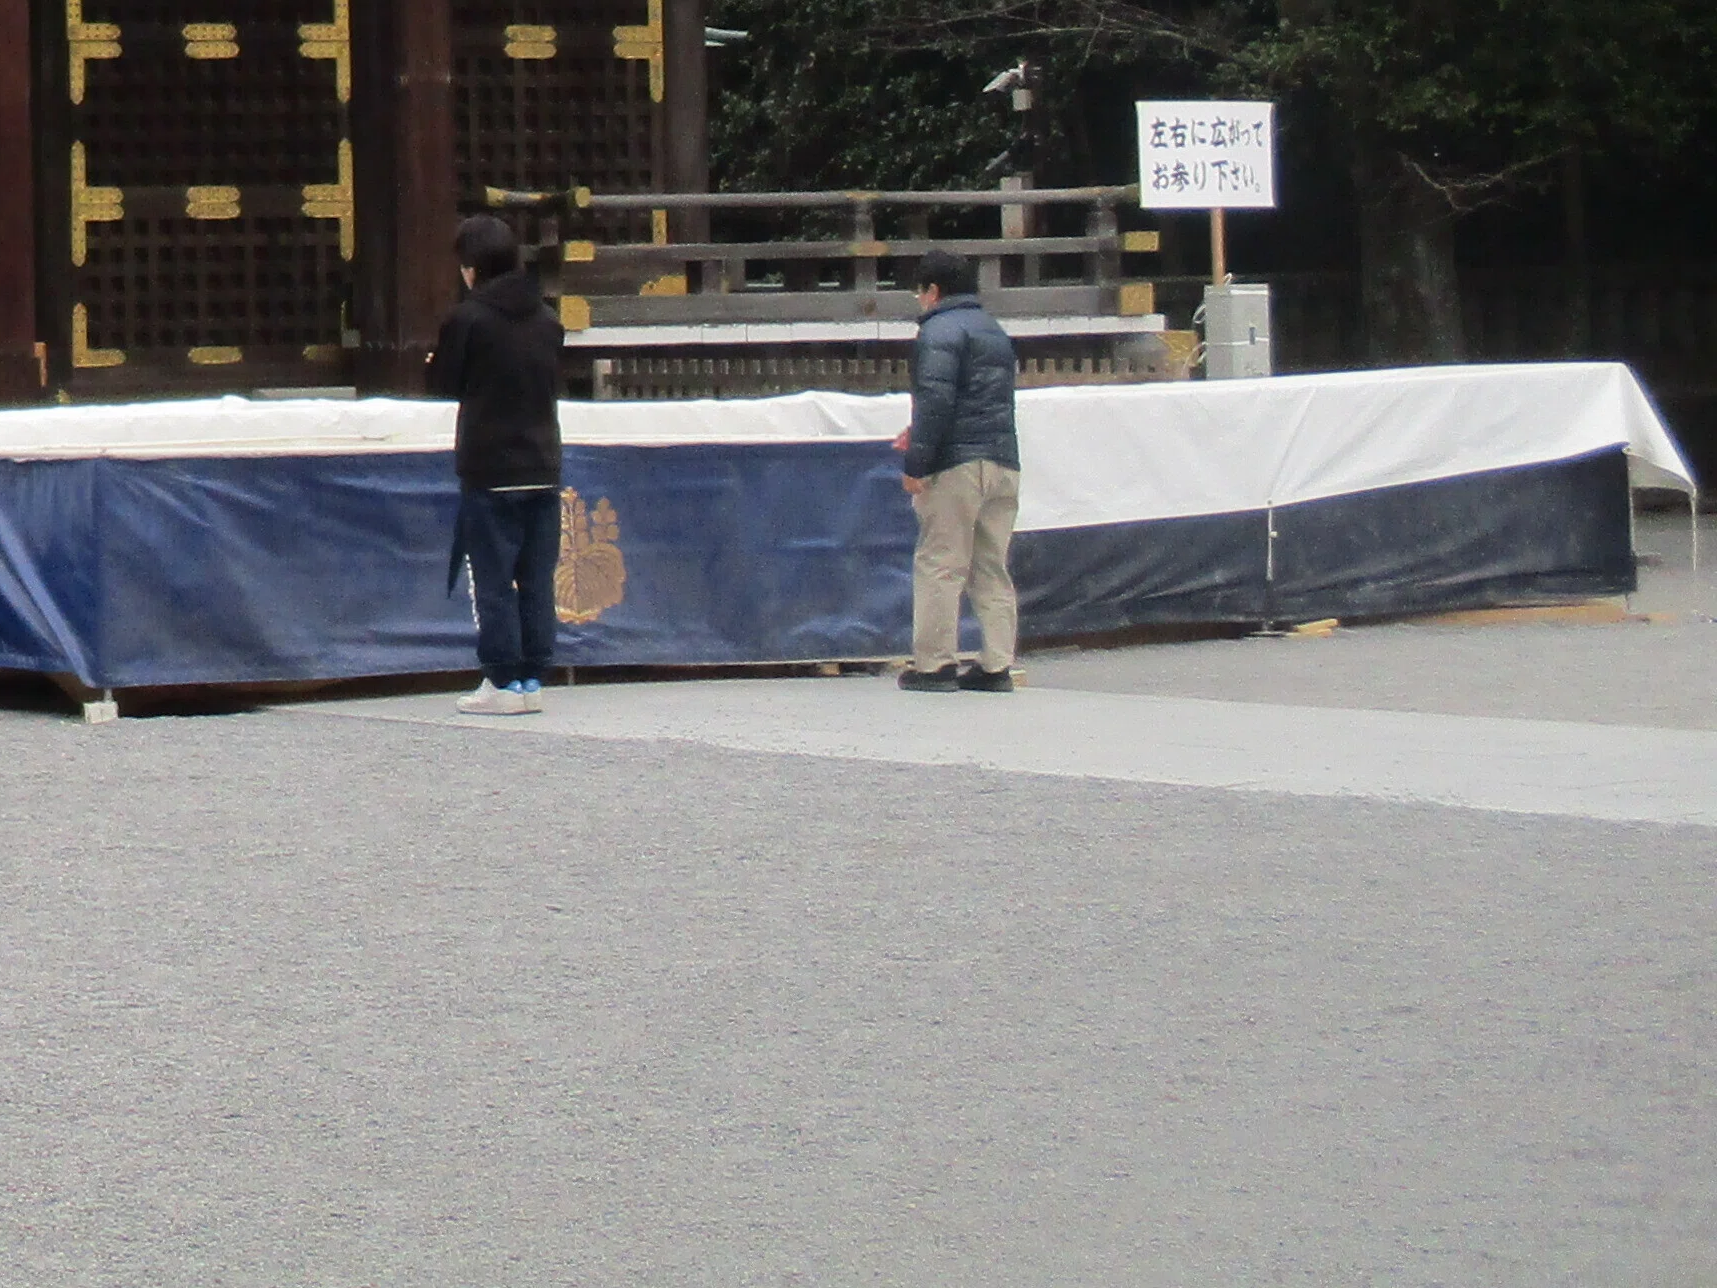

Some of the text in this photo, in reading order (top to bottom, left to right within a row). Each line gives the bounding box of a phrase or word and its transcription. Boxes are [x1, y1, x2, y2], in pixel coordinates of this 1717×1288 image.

[1149, 116, 1264, 149] 左右に広がって
[1151, 159, 1262, 194] お参り下さい。
